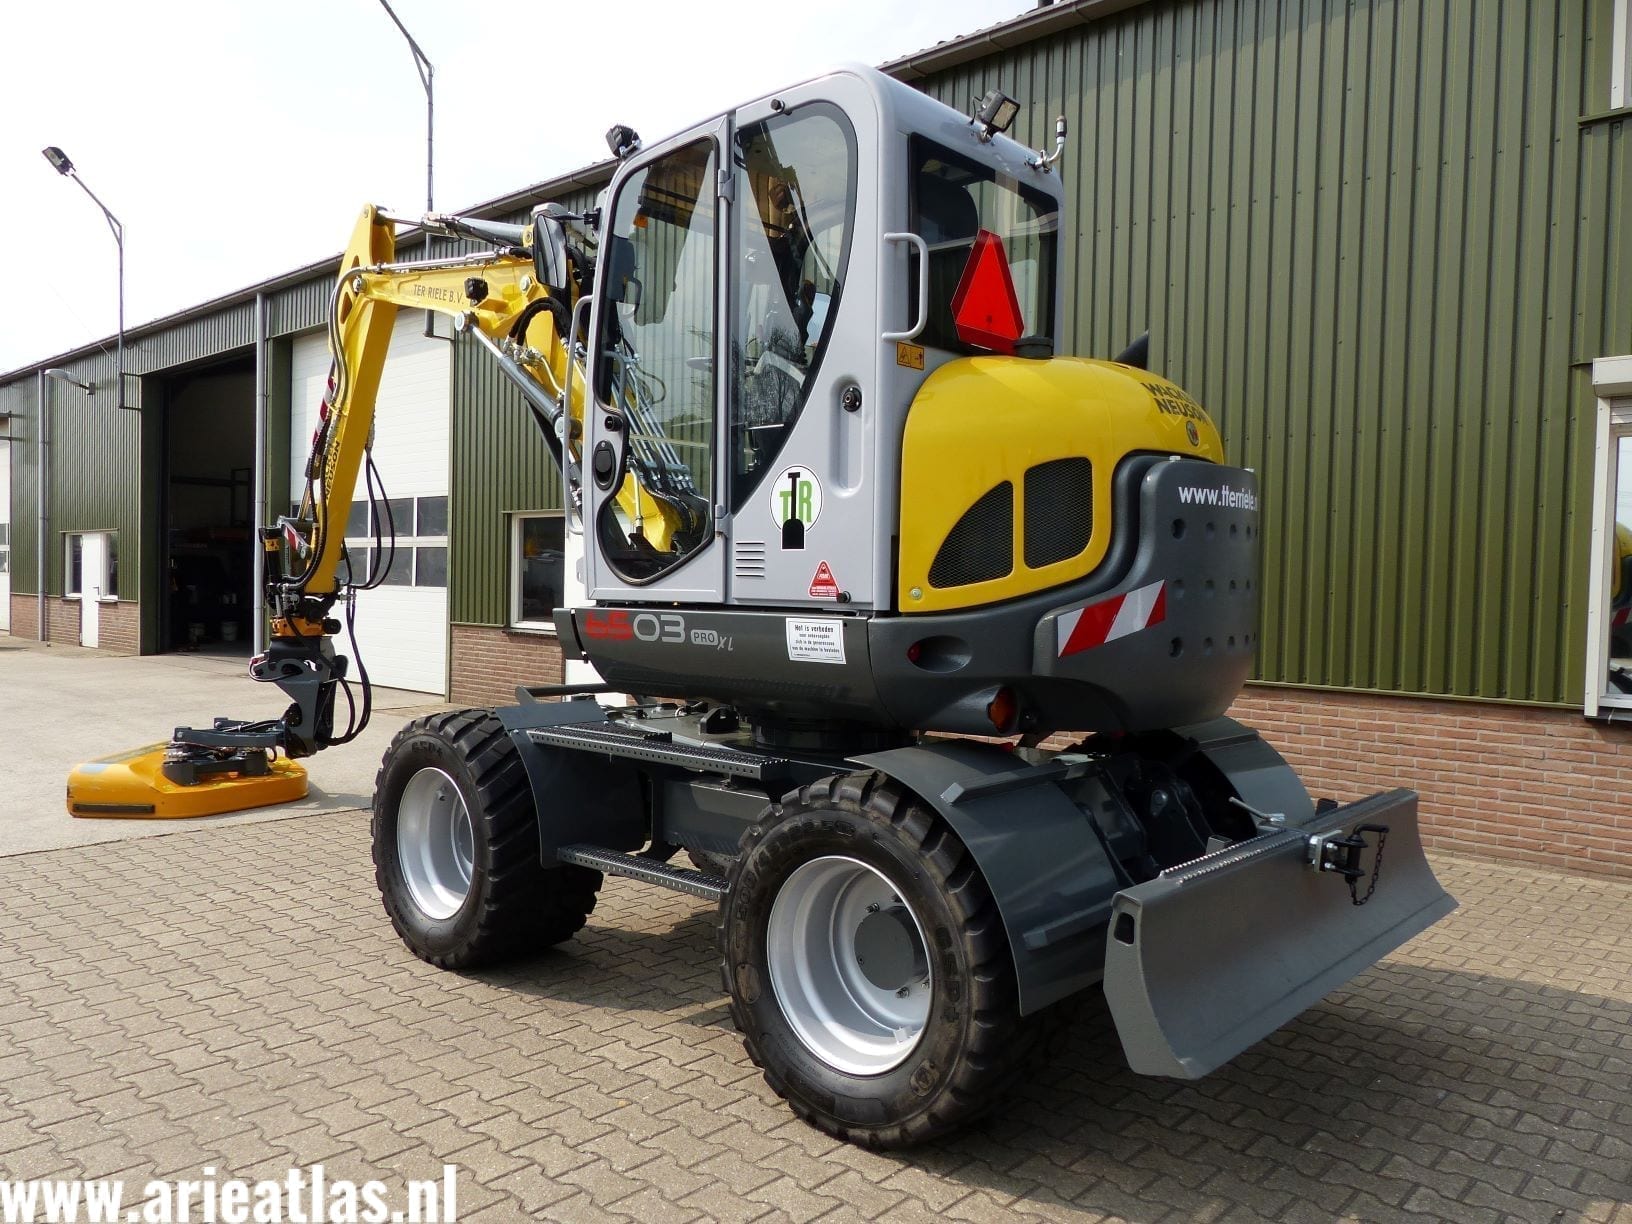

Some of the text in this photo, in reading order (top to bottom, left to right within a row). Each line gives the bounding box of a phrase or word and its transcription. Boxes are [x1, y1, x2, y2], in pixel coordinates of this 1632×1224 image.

[413, 284, 426, 297] TER
[428, 286, 447, 302] RIELE
[1153, 398, 1208, 426] NEUSO
[692, 631, 716, 644] PRO
